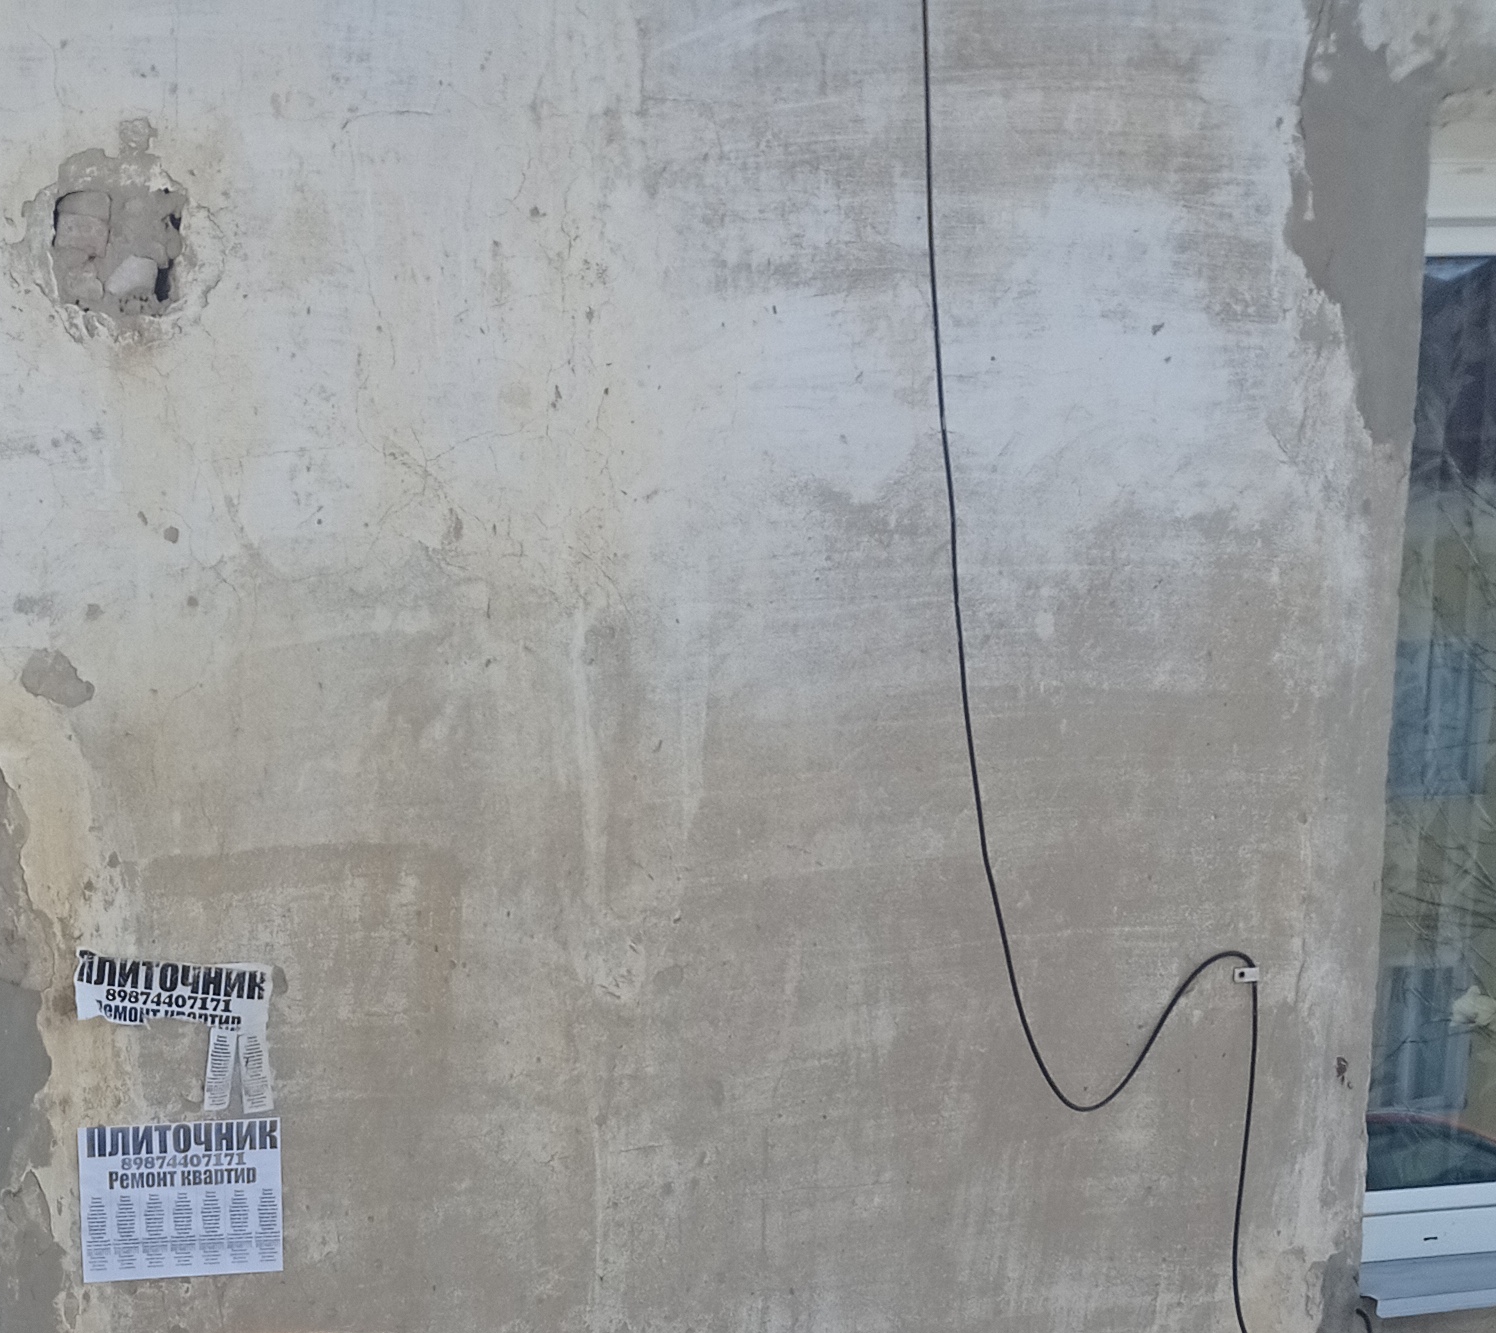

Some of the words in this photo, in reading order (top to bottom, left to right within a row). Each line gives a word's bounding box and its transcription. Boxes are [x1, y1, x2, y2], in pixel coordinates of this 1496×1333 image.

[106, 988, 232, 1013] 89874407171
[87, 1119, 278, 1158] ПЛИТОЧНИК
[121, 1152, 246, 1171] 89874407171
[109, 1170, 177, 1190] Ремонт
[181, 1167, 257, 1187] квартир
